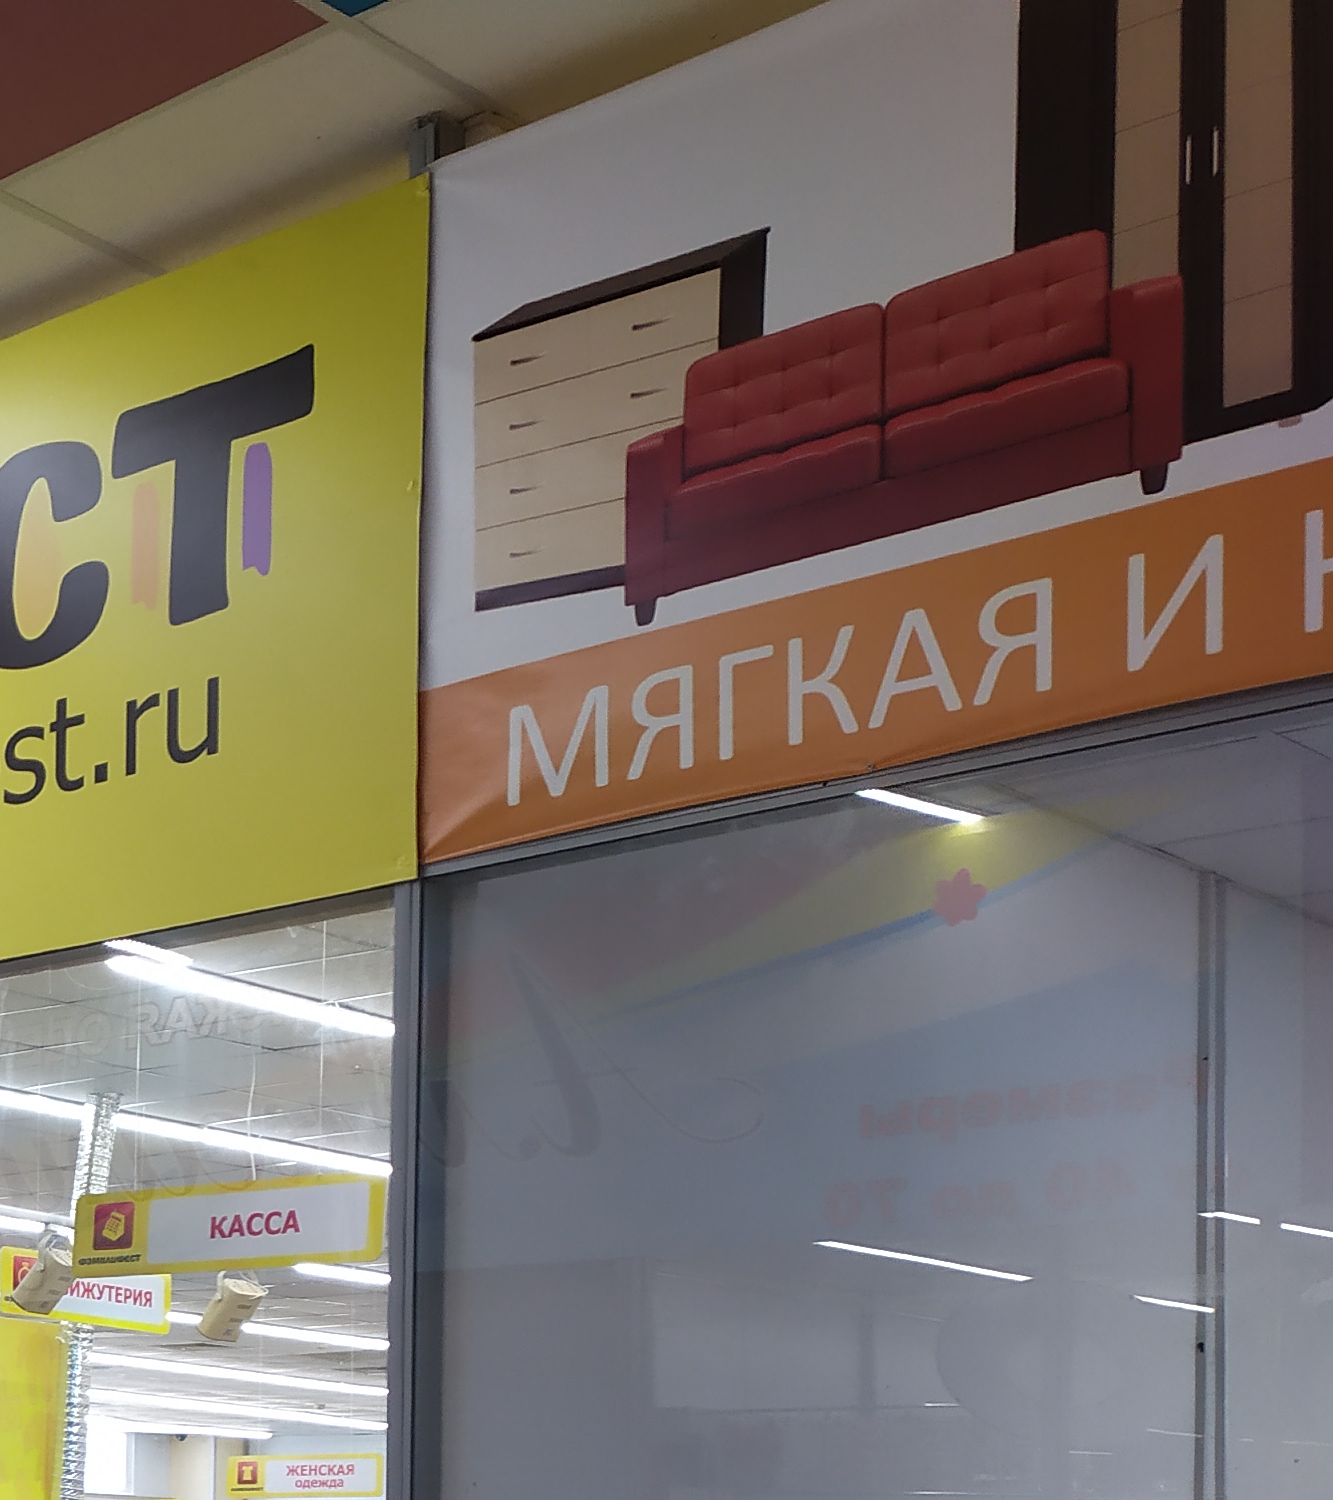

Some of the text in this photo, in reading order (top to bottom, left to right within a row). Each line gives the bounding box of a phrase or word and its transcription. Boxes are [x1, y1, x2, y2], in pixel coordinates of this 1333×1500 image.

[505, 577, 1054, 806] МЯГКАЯ
[1127, 533, 1226, 671] И
[209, 1210, 300, 1239] КАССА
[64, 1280, 153, 1308] ИЖУТЕРИЯ
[286, 1464, 354, 1477] ЖЕНСКАЯ
[295, 1477, 344, 1489] одежда
